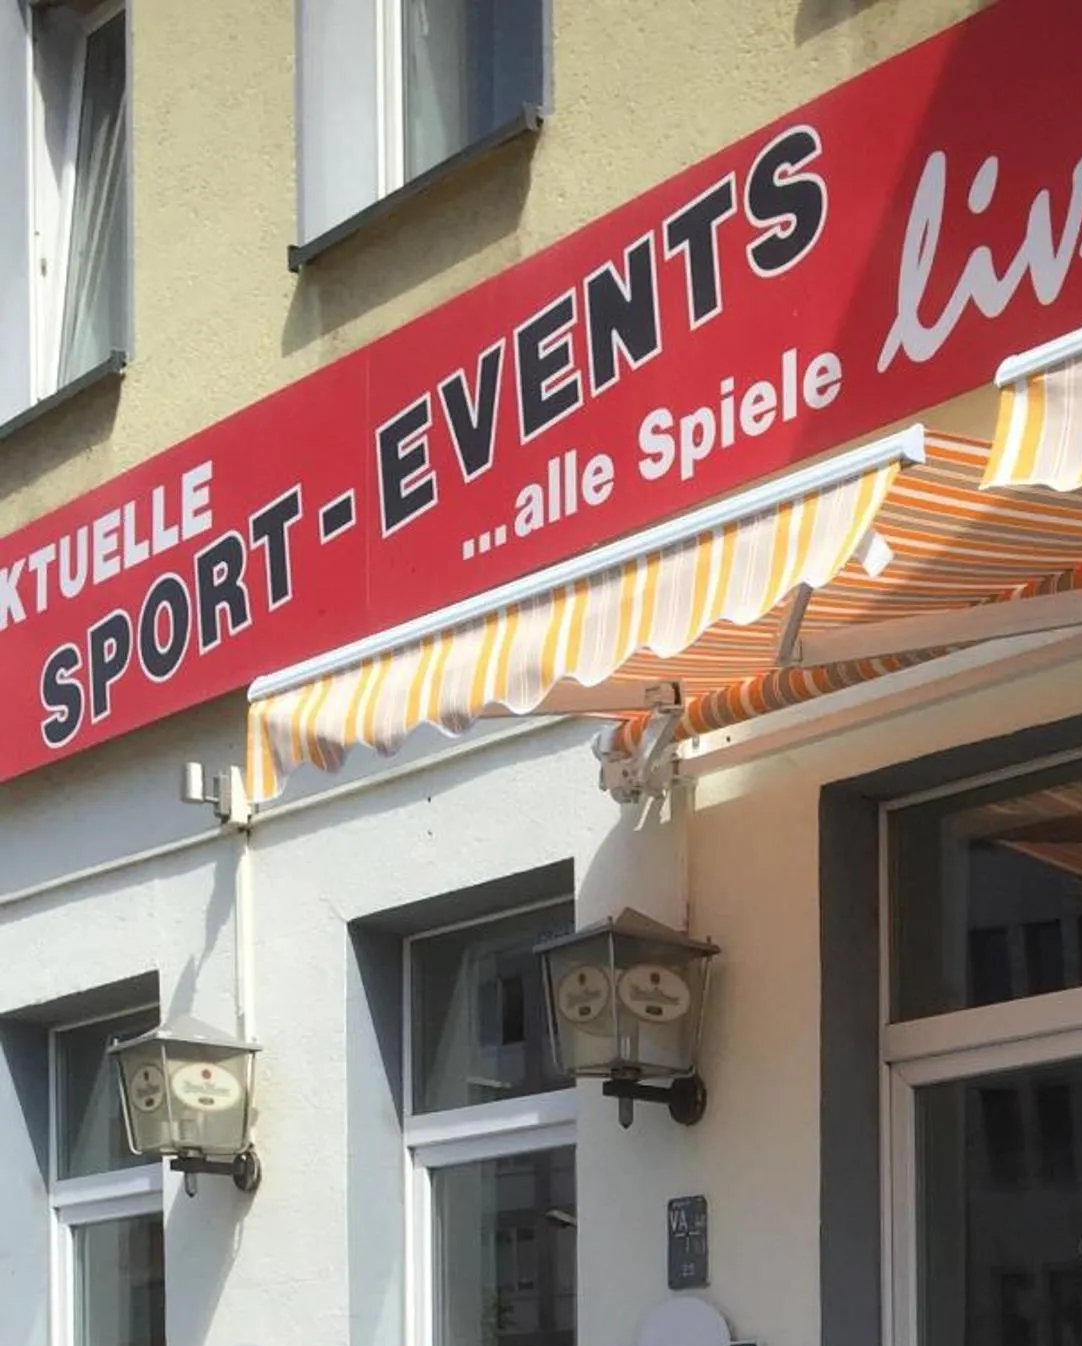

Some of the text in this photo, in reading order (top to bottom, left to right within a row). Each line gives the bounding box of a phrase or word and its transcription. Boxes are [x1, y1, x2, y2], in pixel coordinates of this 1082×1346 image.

[40, 483, 304, 747] SPORT
[375, 124, 829, 540] EVENTS
[638, 349, 843, 480] Spiele
